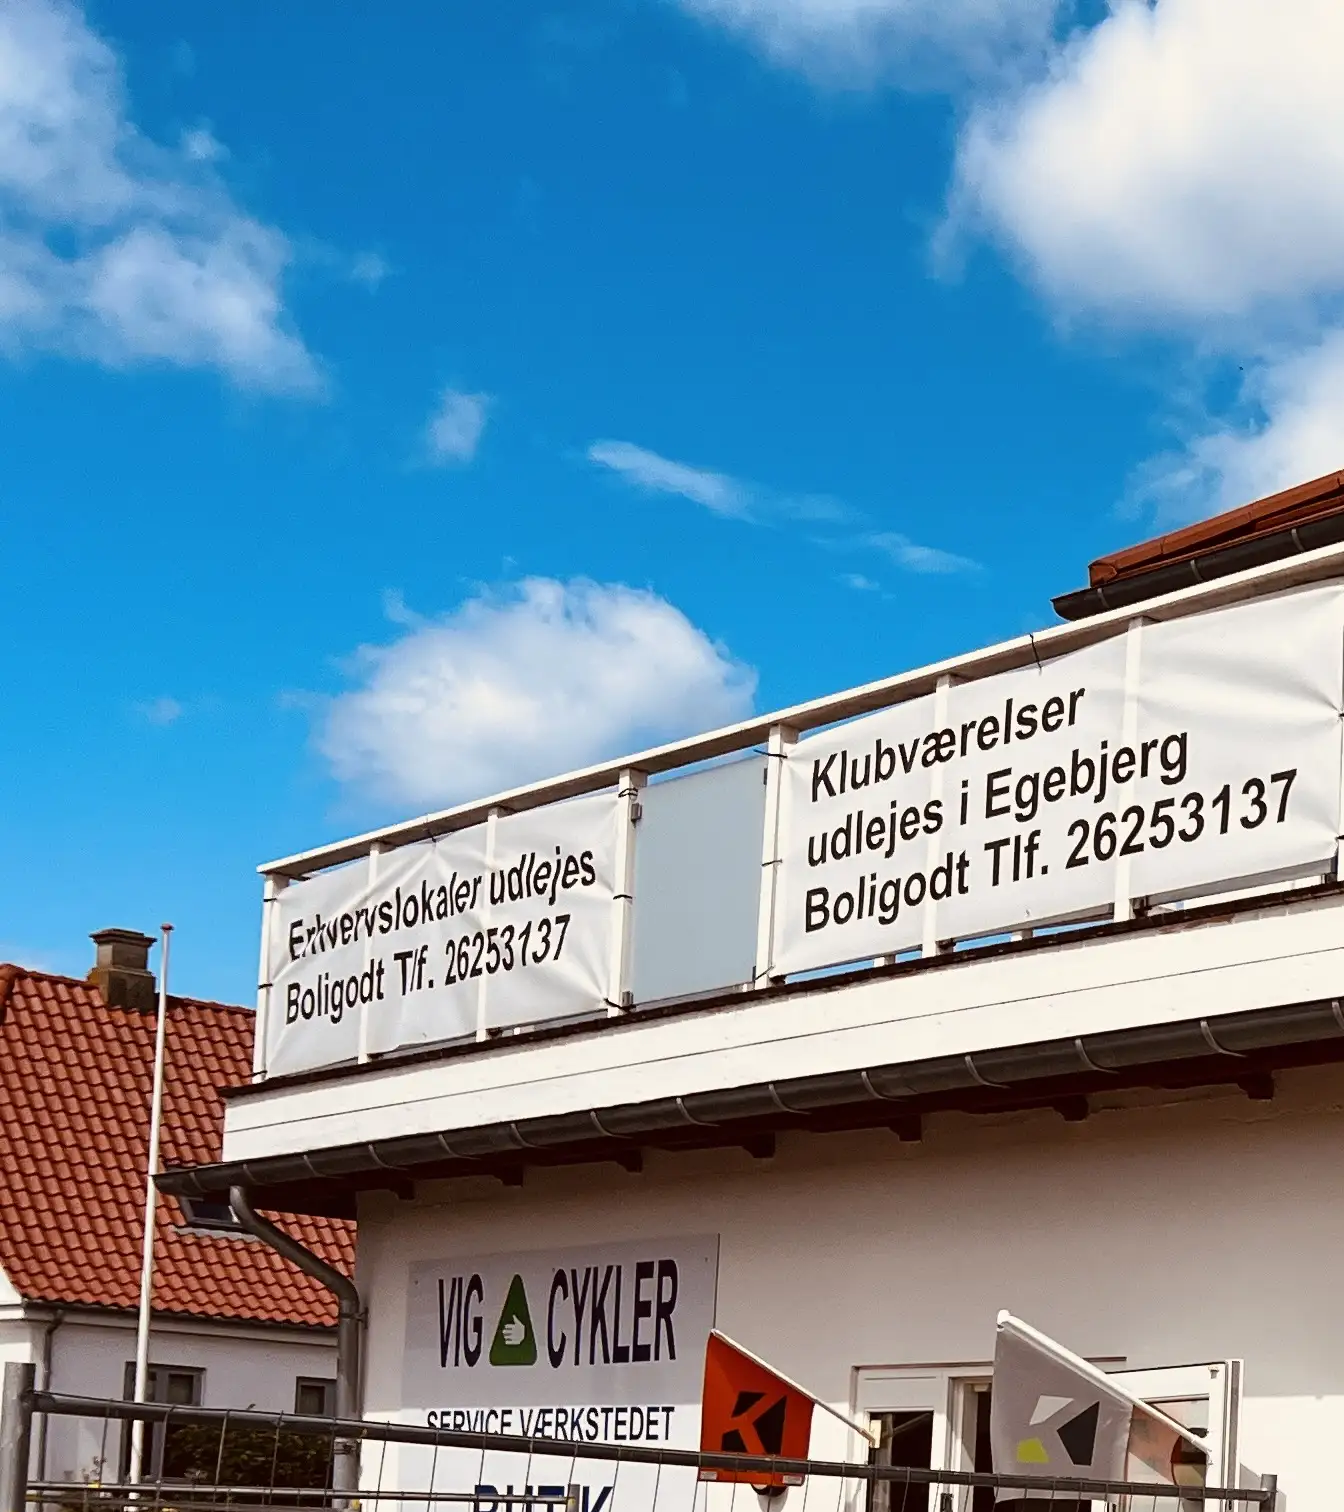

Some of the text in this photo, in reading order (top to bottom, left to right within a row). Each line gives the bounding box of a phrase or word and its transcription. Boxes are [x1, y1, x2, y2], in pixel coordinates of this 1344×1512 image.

[807, 732, 1188, 867] udlejes i Egebjerg
[811, 688, 1085, 802] Klubværelser
[490, 846, 596, 905] udlejes
[805, 768, 1298, 933] Boligodt Tlf. 26253137
[286, 914, 571, 1025] Boligodt Tlf. 26253137
[438, 1259, 679, 1369] VIG CYKLER
[519, 1406, 675, 1441] VÆRKSTEDET
